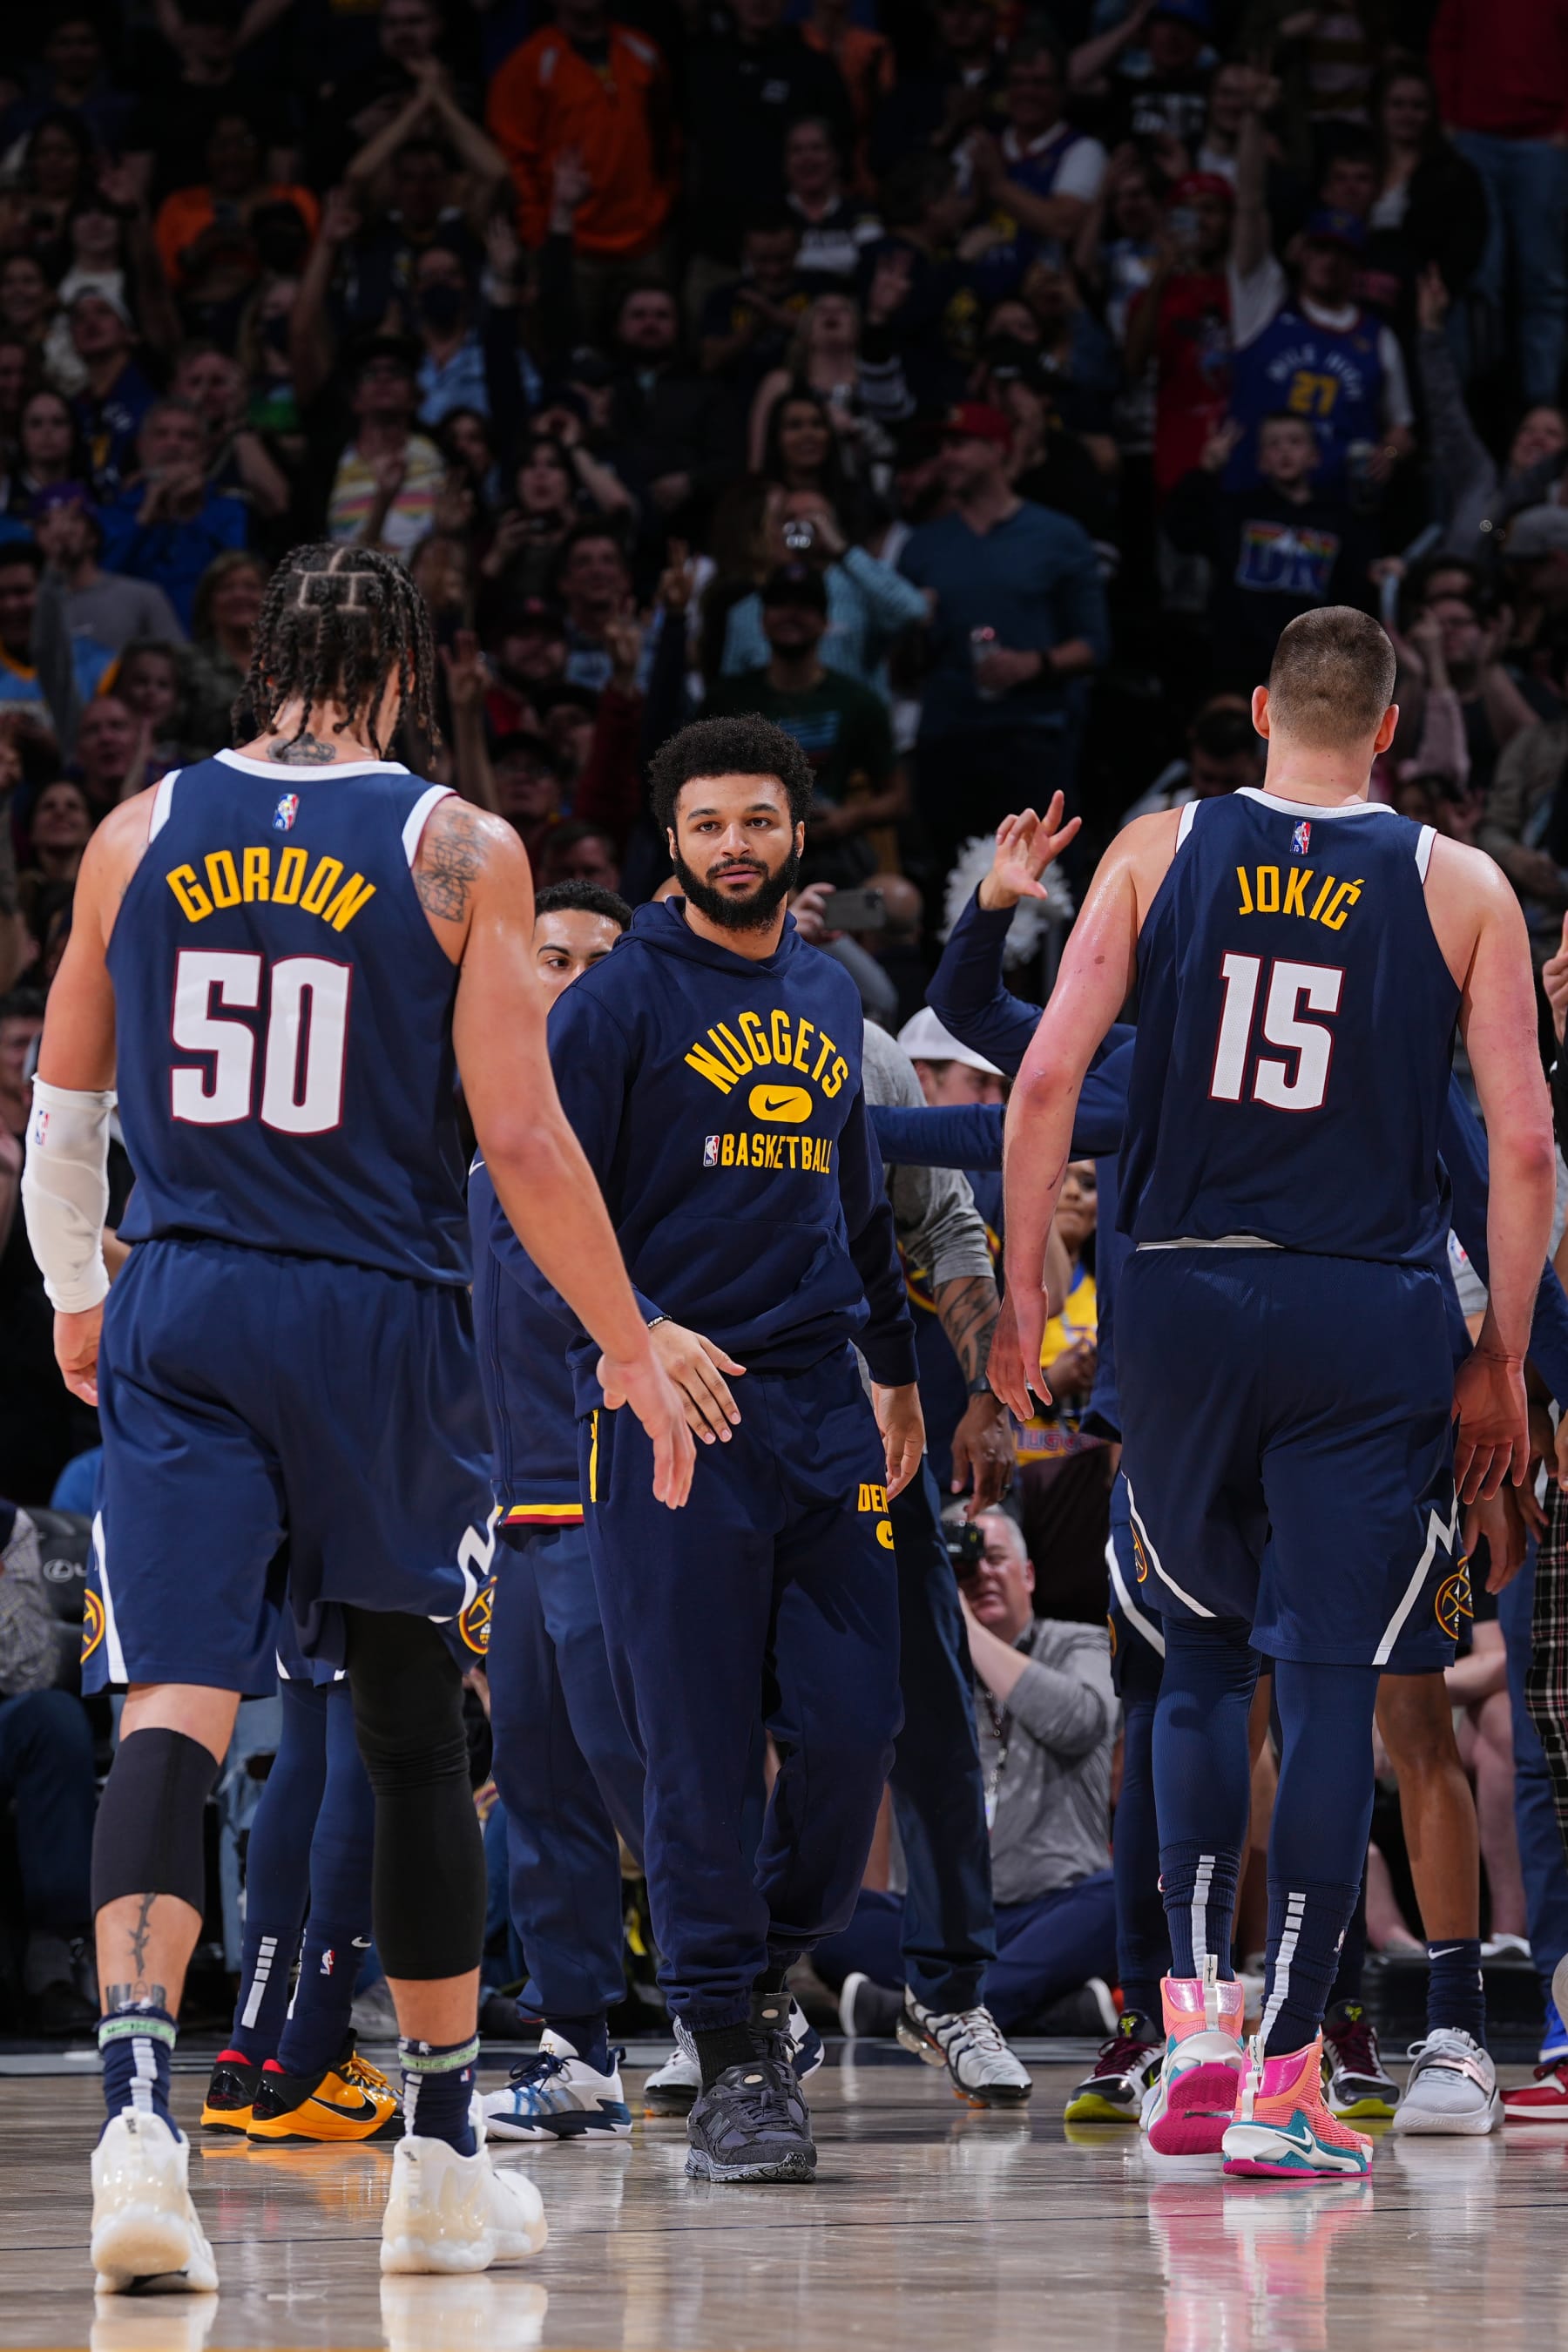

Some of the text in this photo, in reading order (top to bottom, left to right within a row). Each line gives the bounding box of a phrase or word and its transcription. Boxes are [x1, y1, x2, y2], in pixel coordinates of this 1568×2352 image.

[166, 846, 377, 933] GORDON
[1235, 864, 1366, 931] JOKIĆ
[169, 947, 355, 1137] 50
[683, 1008, 849, 1099] NUGGETS
[1206, 949, 1348, 1114] 15
[720, 1132, 834, 1175] BASKETBALL
